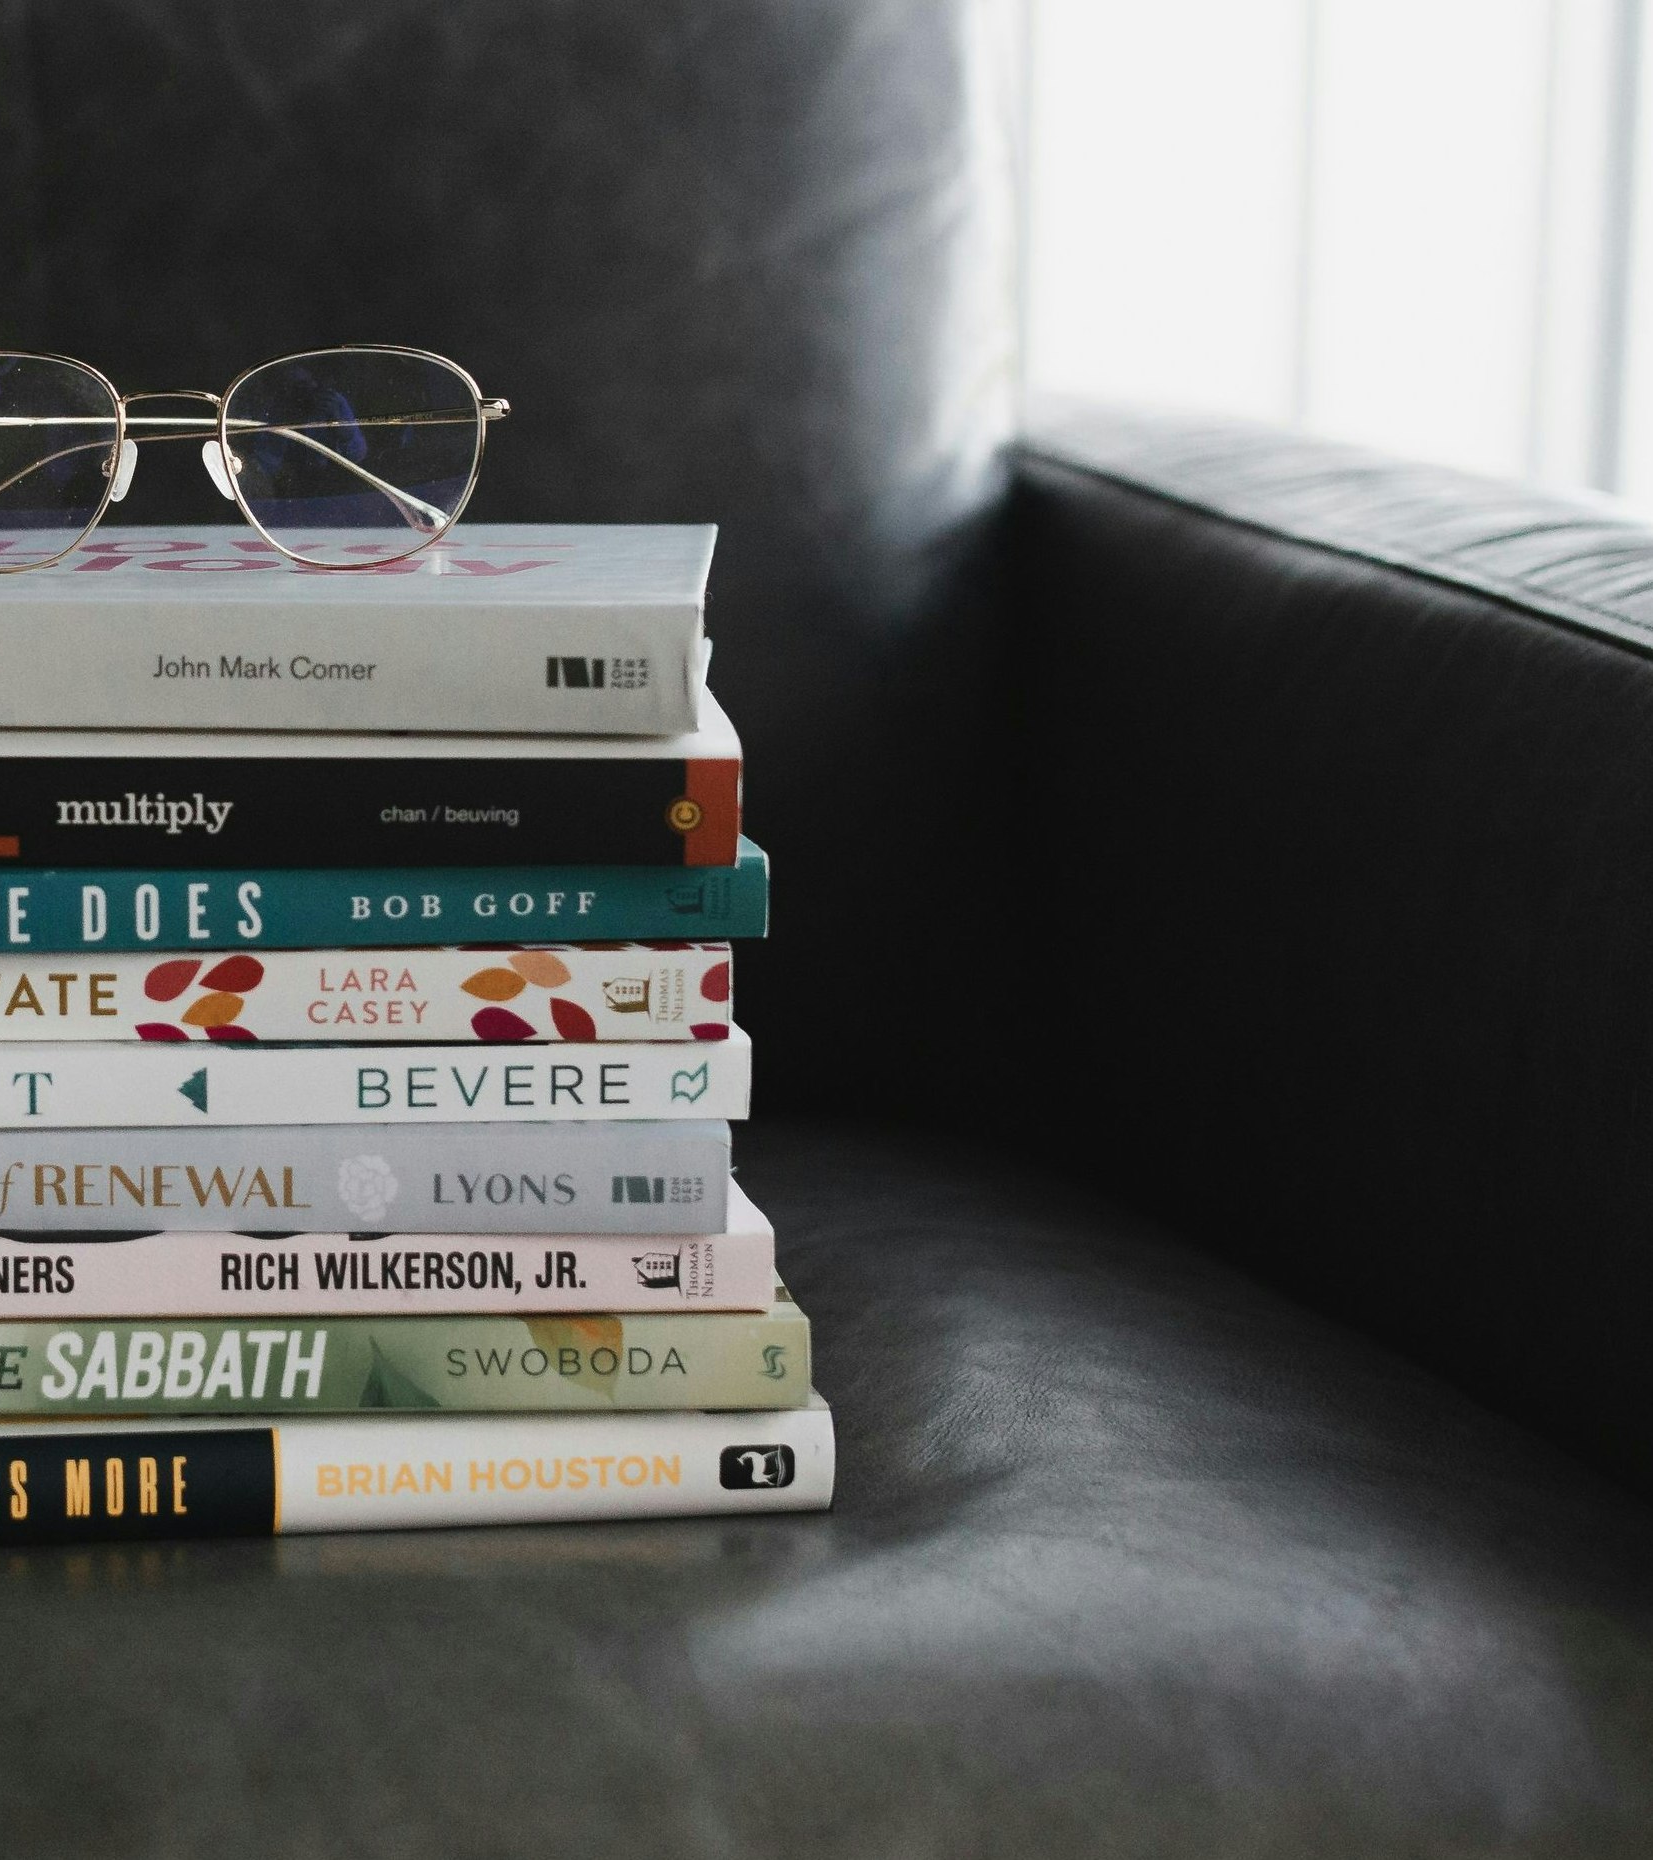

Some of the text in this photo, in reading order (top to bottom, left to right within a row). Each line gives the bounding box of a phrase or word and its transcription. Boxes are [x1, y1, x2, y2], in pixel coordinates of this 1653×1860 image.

[153, 655, 376, 681] John Mark Comer
[57, 793, 233, 834] multiply
[380, 806, 427, 822] chan
[445, 806, 519, 827] beuving
[82, 882, 262, 941] DOES
[352, 892, 595, 919] BOB GOFF
[320, 968, 417, 992] LARA
[308, 1001, 428, 1024] CASEY
[358, 1064, 630, 1109] BEVERE
[34, 1165, 310, 1208] RENEWAL
[434, 1174, 576, 1205] LYONS
[221, 1251, 586, 1294] RICH WILKERSON, JR.
[41, 1329, 326, 1399] SABBATH
[446, 1346, 687, 1377] SWOBODA
[66, 1456, 186, 1516] MORE
[317, 1456, 682, 1498] BRIAN HOUSTON
